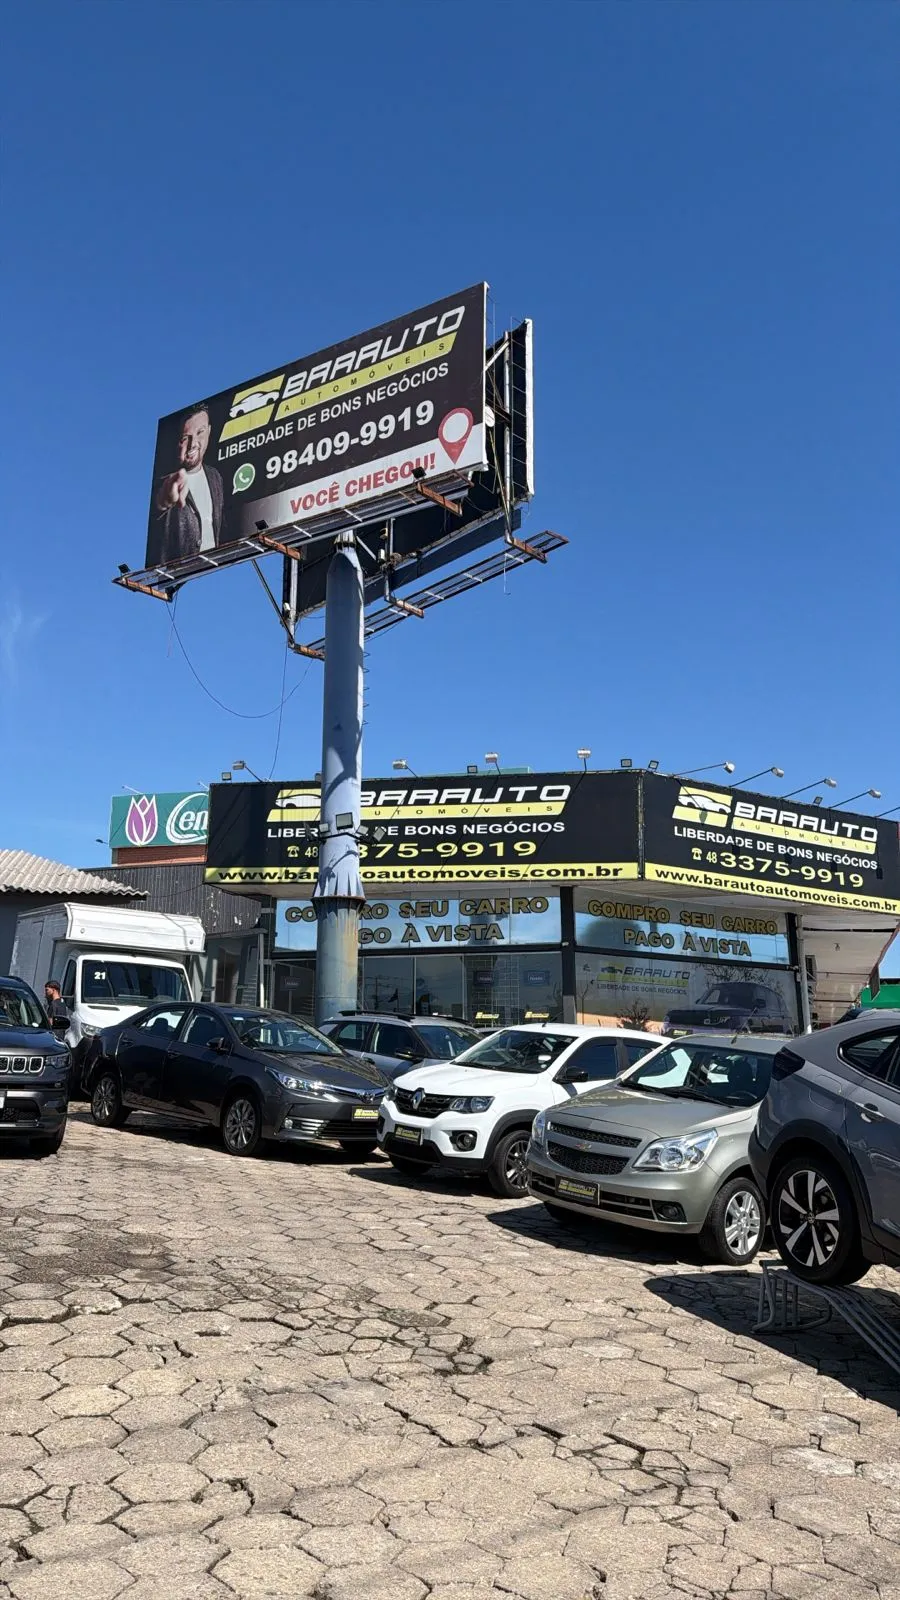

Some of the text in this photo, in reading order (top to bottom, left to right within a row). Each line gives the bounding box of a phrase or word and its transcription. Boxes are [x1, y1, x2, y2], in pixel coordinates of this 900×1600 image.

[282, 305, 466, 399] BARAUTO
[284, 342, 445, 412] AUTOMÓVEIS
[217, 362, 449, 461] LIBERDADE DE BONS NEGÓCIOS
[265, 400, 434, 479] 98409-9919
[290, 452, 436, 514] VOCÊ CHEGOU!
[374, 805, 553, 816] UTOMÓVEIS
[404, 824, 457, 835] BONS
[463, 821, 565, 835] NEGÓCIOS
[734, 801, 878, 842] BARAUTO
[304, 841, 537, 859] 48 75-9919
[674, 826, 878, 870] LIBERDADE DE BONS NEGÓCIOS
[740, 821, 870, 850] AUTOMÓVEIS
[218, 866, 623, 880] www.baroautomoveis.com.br
[706, 851, 864, 888] 48 3375-9919
[655, 869, 897, 912] www.barautoautomoveis.com.br
[285, 896, 550, 922] CORO SEU CARRO
[588, 900, 778, 935] COMPRO SEU CARRO
[358, 923, 504, 944] GO À VISTA
[623, 929, 752, 957] PAGO À VISTA
[94, 971, 106, 980] 21
